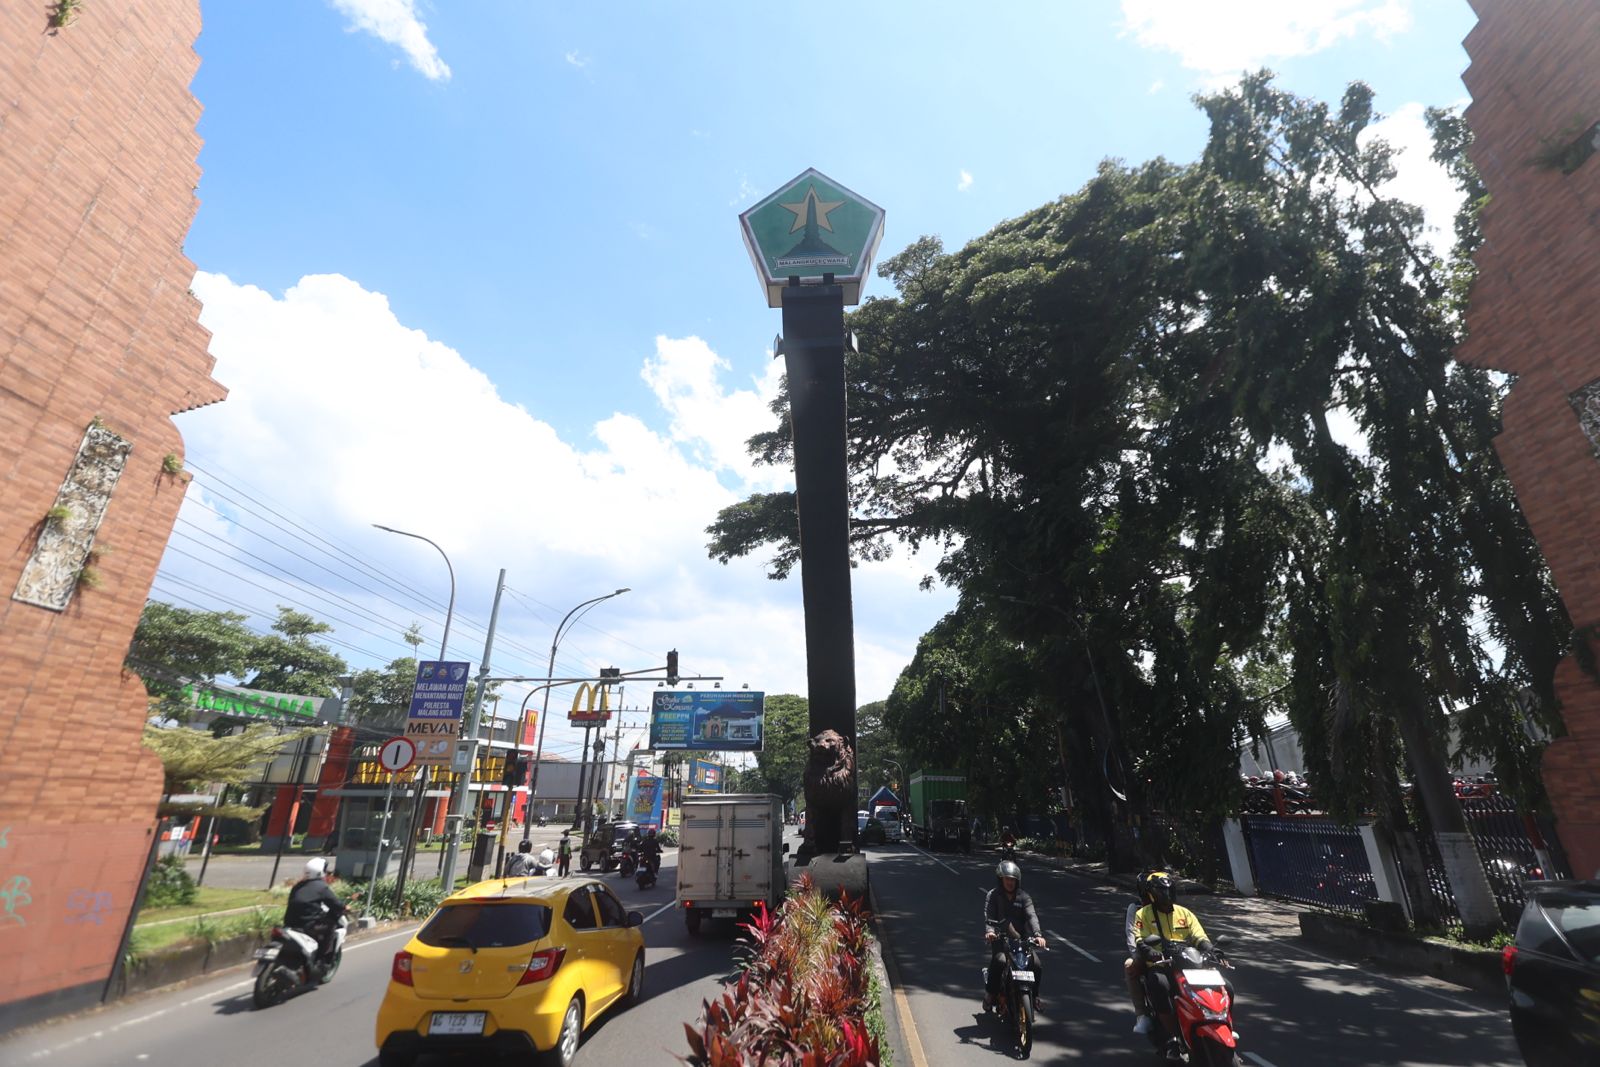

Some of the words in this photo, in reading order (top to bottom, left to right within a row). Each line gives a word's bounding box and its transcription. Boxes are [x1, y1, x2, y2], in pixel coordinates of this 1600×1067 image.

[416, 683, 447, 691] MELAWAN
[447, 684, 464, 692] ARUS
[447, 692, 463, 700] MAUT
[423, 701, 449, 709] POLRESTA
[407, 722, 456, 735] MEVAL
